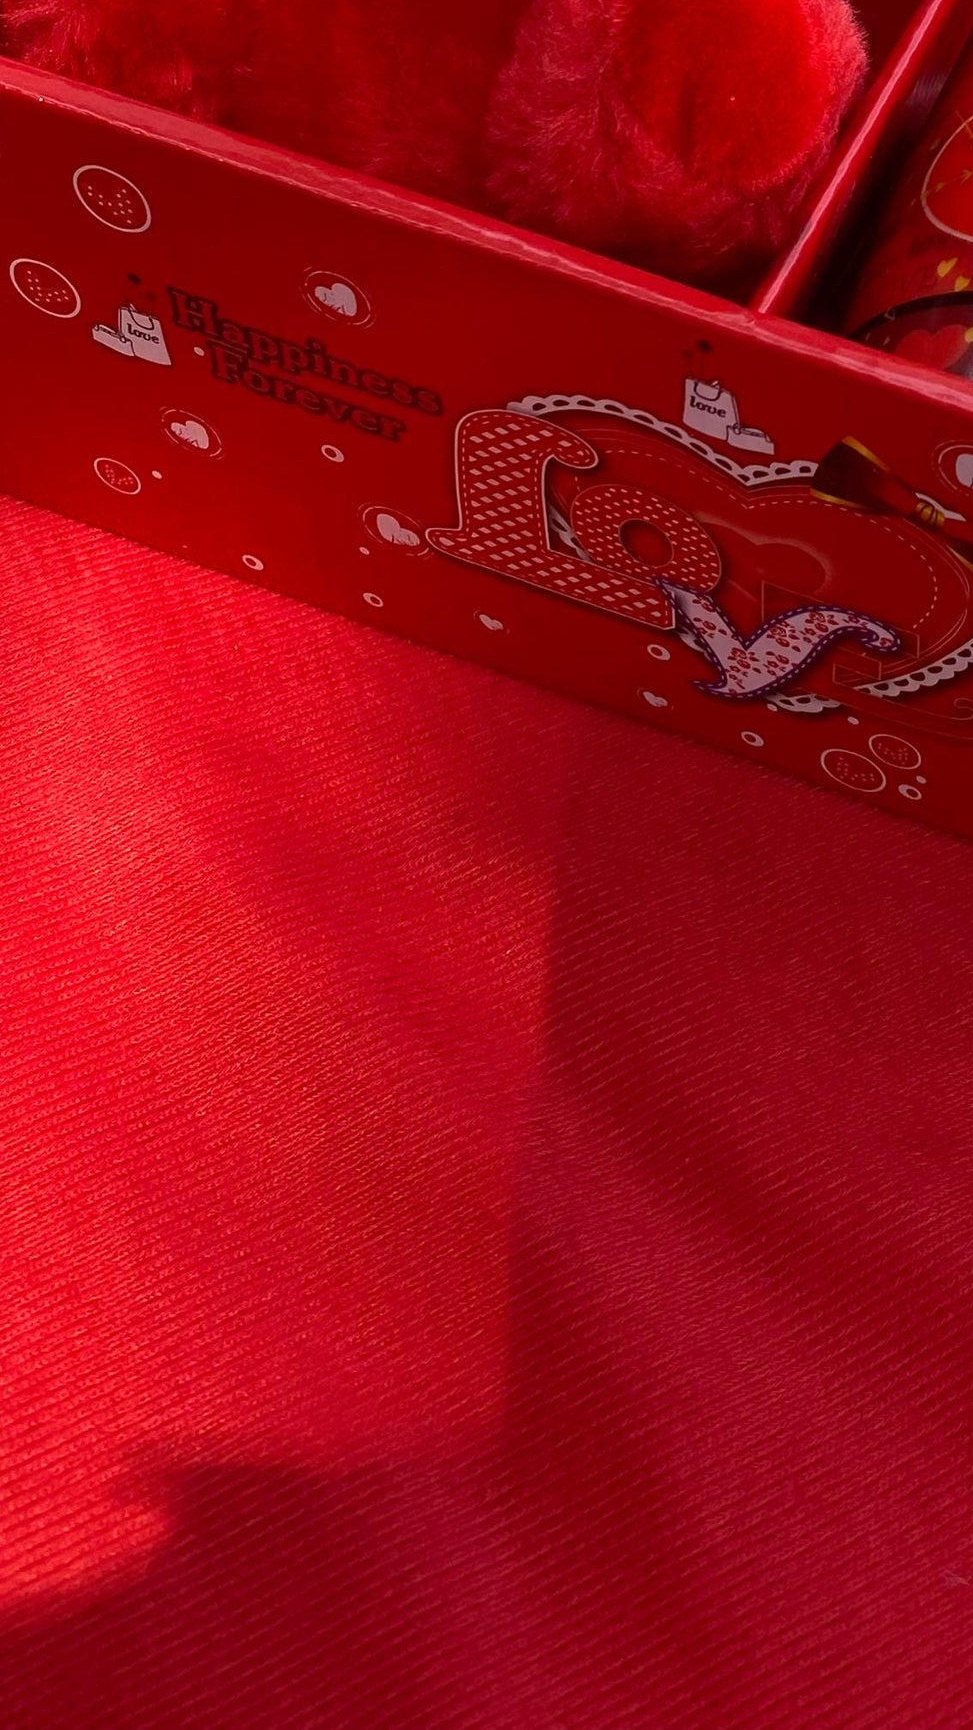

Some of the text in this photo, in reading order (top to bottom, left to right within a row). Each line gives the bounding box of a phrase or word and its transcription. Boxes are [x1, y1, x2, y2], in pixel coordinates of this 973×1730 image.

[128, 322, 161, 345] love
[167, 286, 444, 417] Happiness
[206, 340, 408, 443] Forever
[689, 395, 728, 419] love
